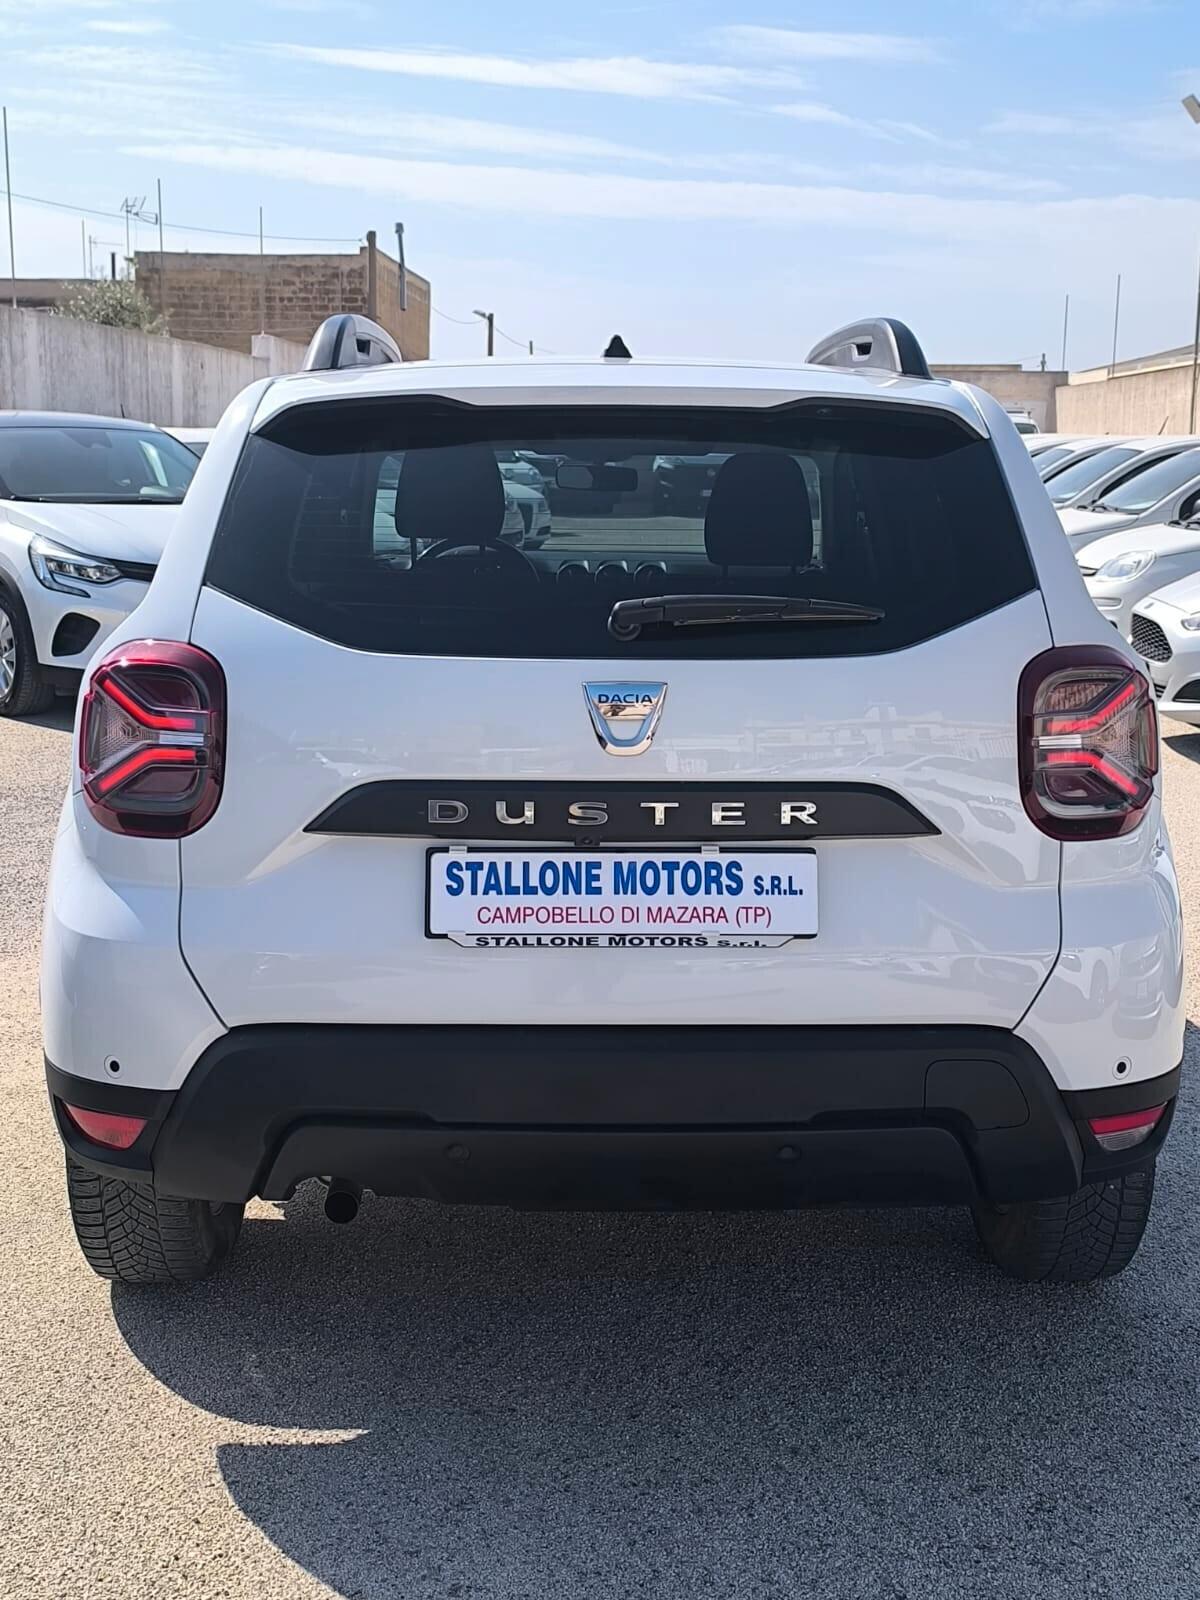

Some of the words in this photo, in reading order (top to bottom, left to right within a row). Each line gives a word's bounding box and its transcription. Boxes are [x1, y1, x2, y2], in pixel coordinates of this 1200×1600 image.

[597, 693, 653, 704] DACIA
[427, 799, 818, 826] DUSTER
[445, 860, 602, 896] STALLONE
[613, 860, 744, 896] MOTORS
[753, 875, 804, 896] S.R.L.
[477, 906, 615, 925] CAMPOBELLO
[621, 906, 640, 924] DI
[647, 906, 728, 924] MAZARA
[735, 906, 772, 928] (TP)
[475, 936, 599, 947] STALLONE
[607, 936, 709, 947] MOTORS
